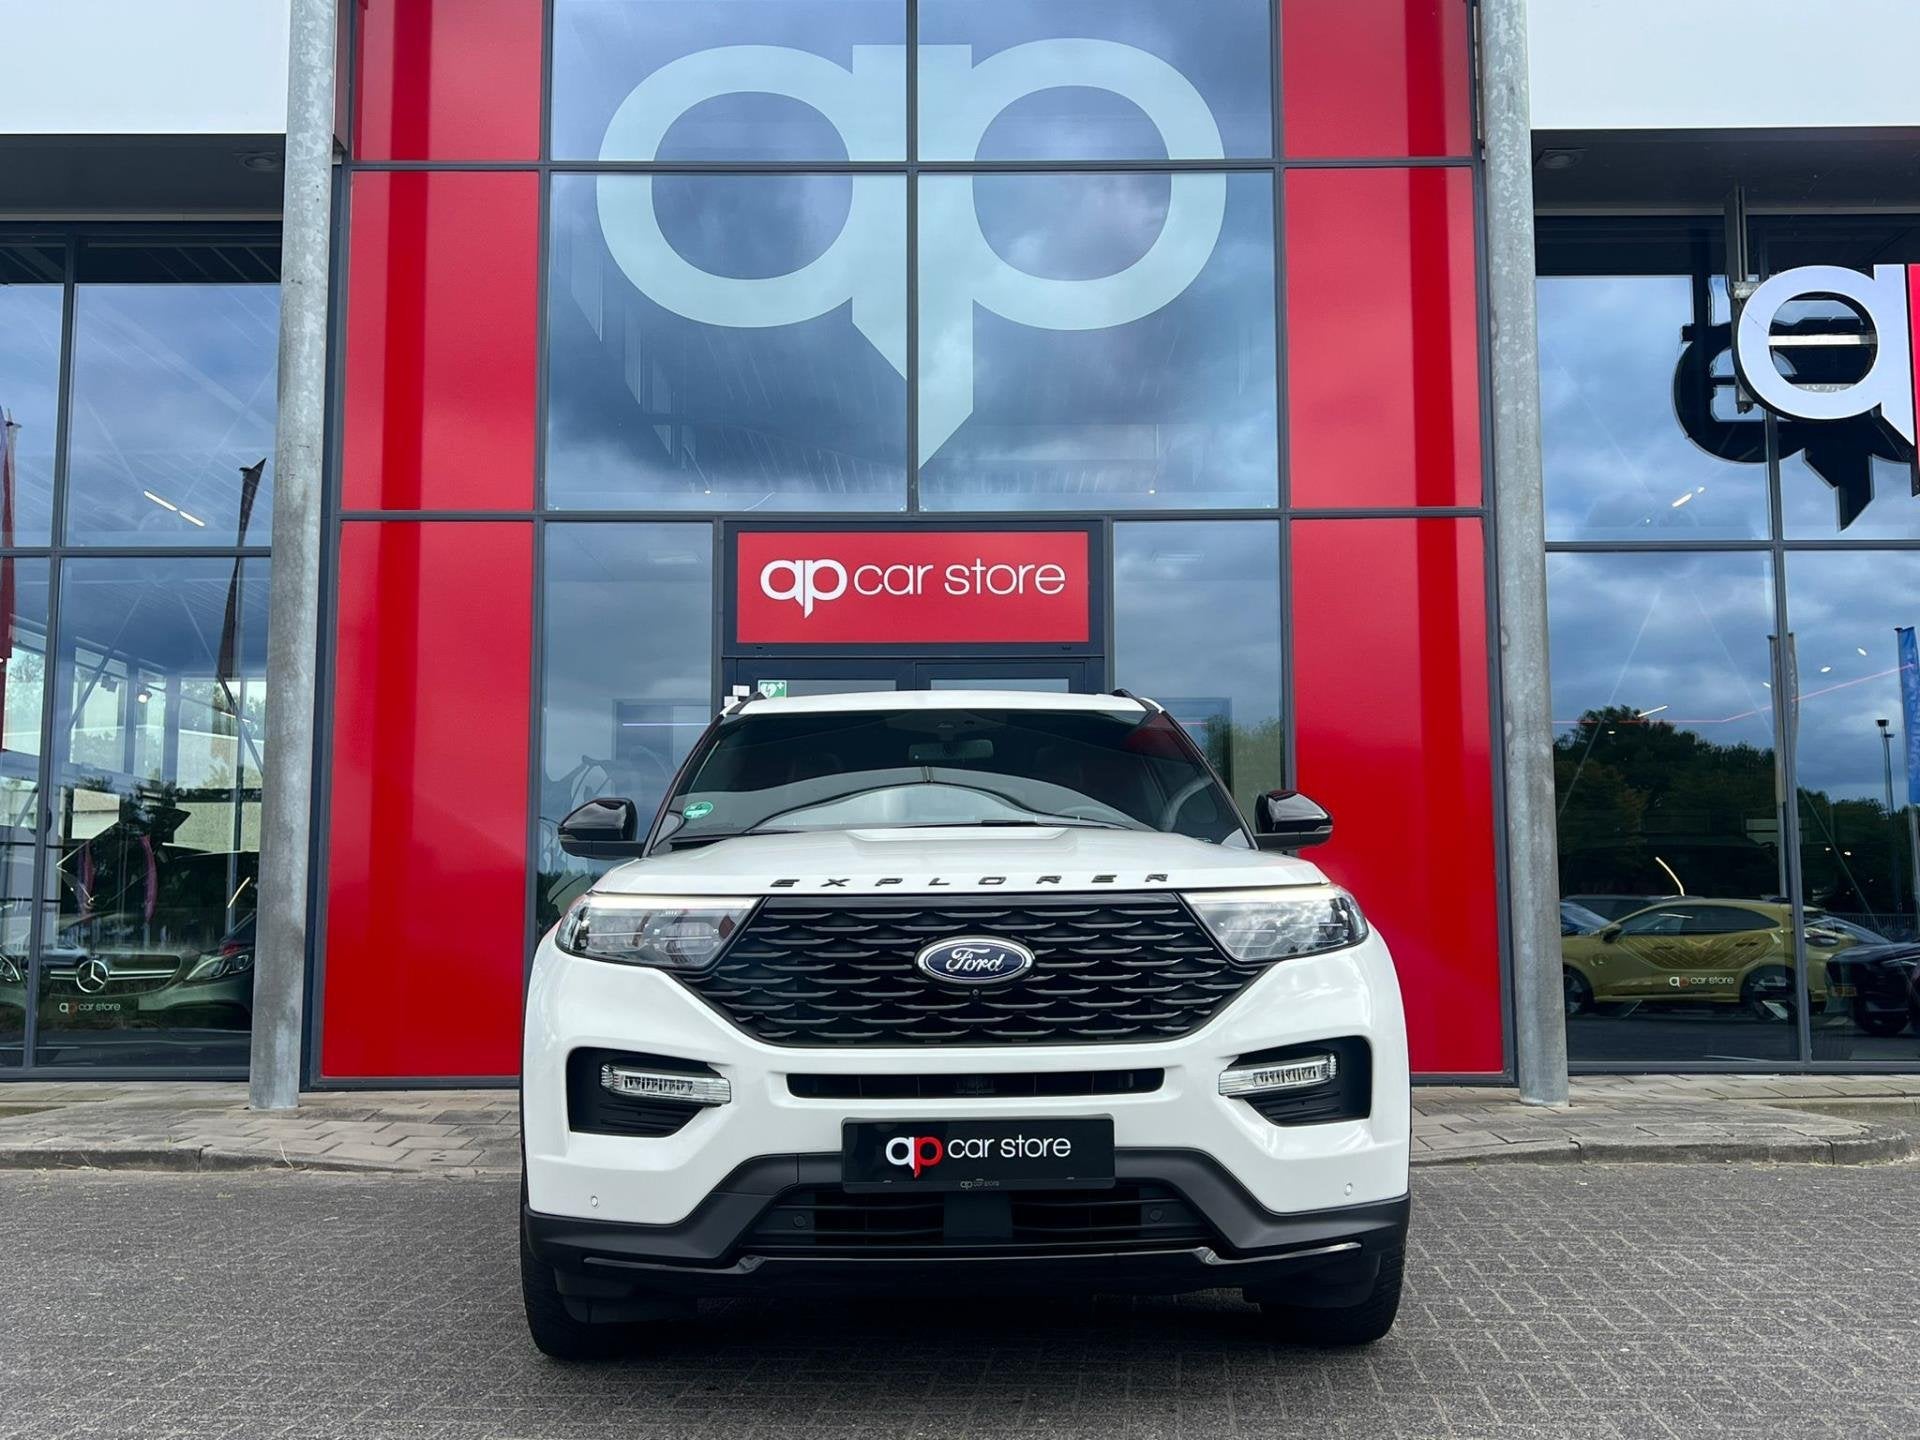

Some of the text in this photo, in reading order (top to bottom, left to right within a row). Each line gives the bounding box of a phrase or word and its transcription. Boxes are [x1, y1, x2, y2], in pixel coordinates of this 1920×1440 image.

[596, 38, 1228, 470] ap
[1737, 264, 1920, 478] a
[760, 557, 1066, 619] ap car store
[769, 873, 1169, 889] EXPLORER
[945, 947, 1005, 973] Ford
[885, 1133, 1072, 1179] ap car store
